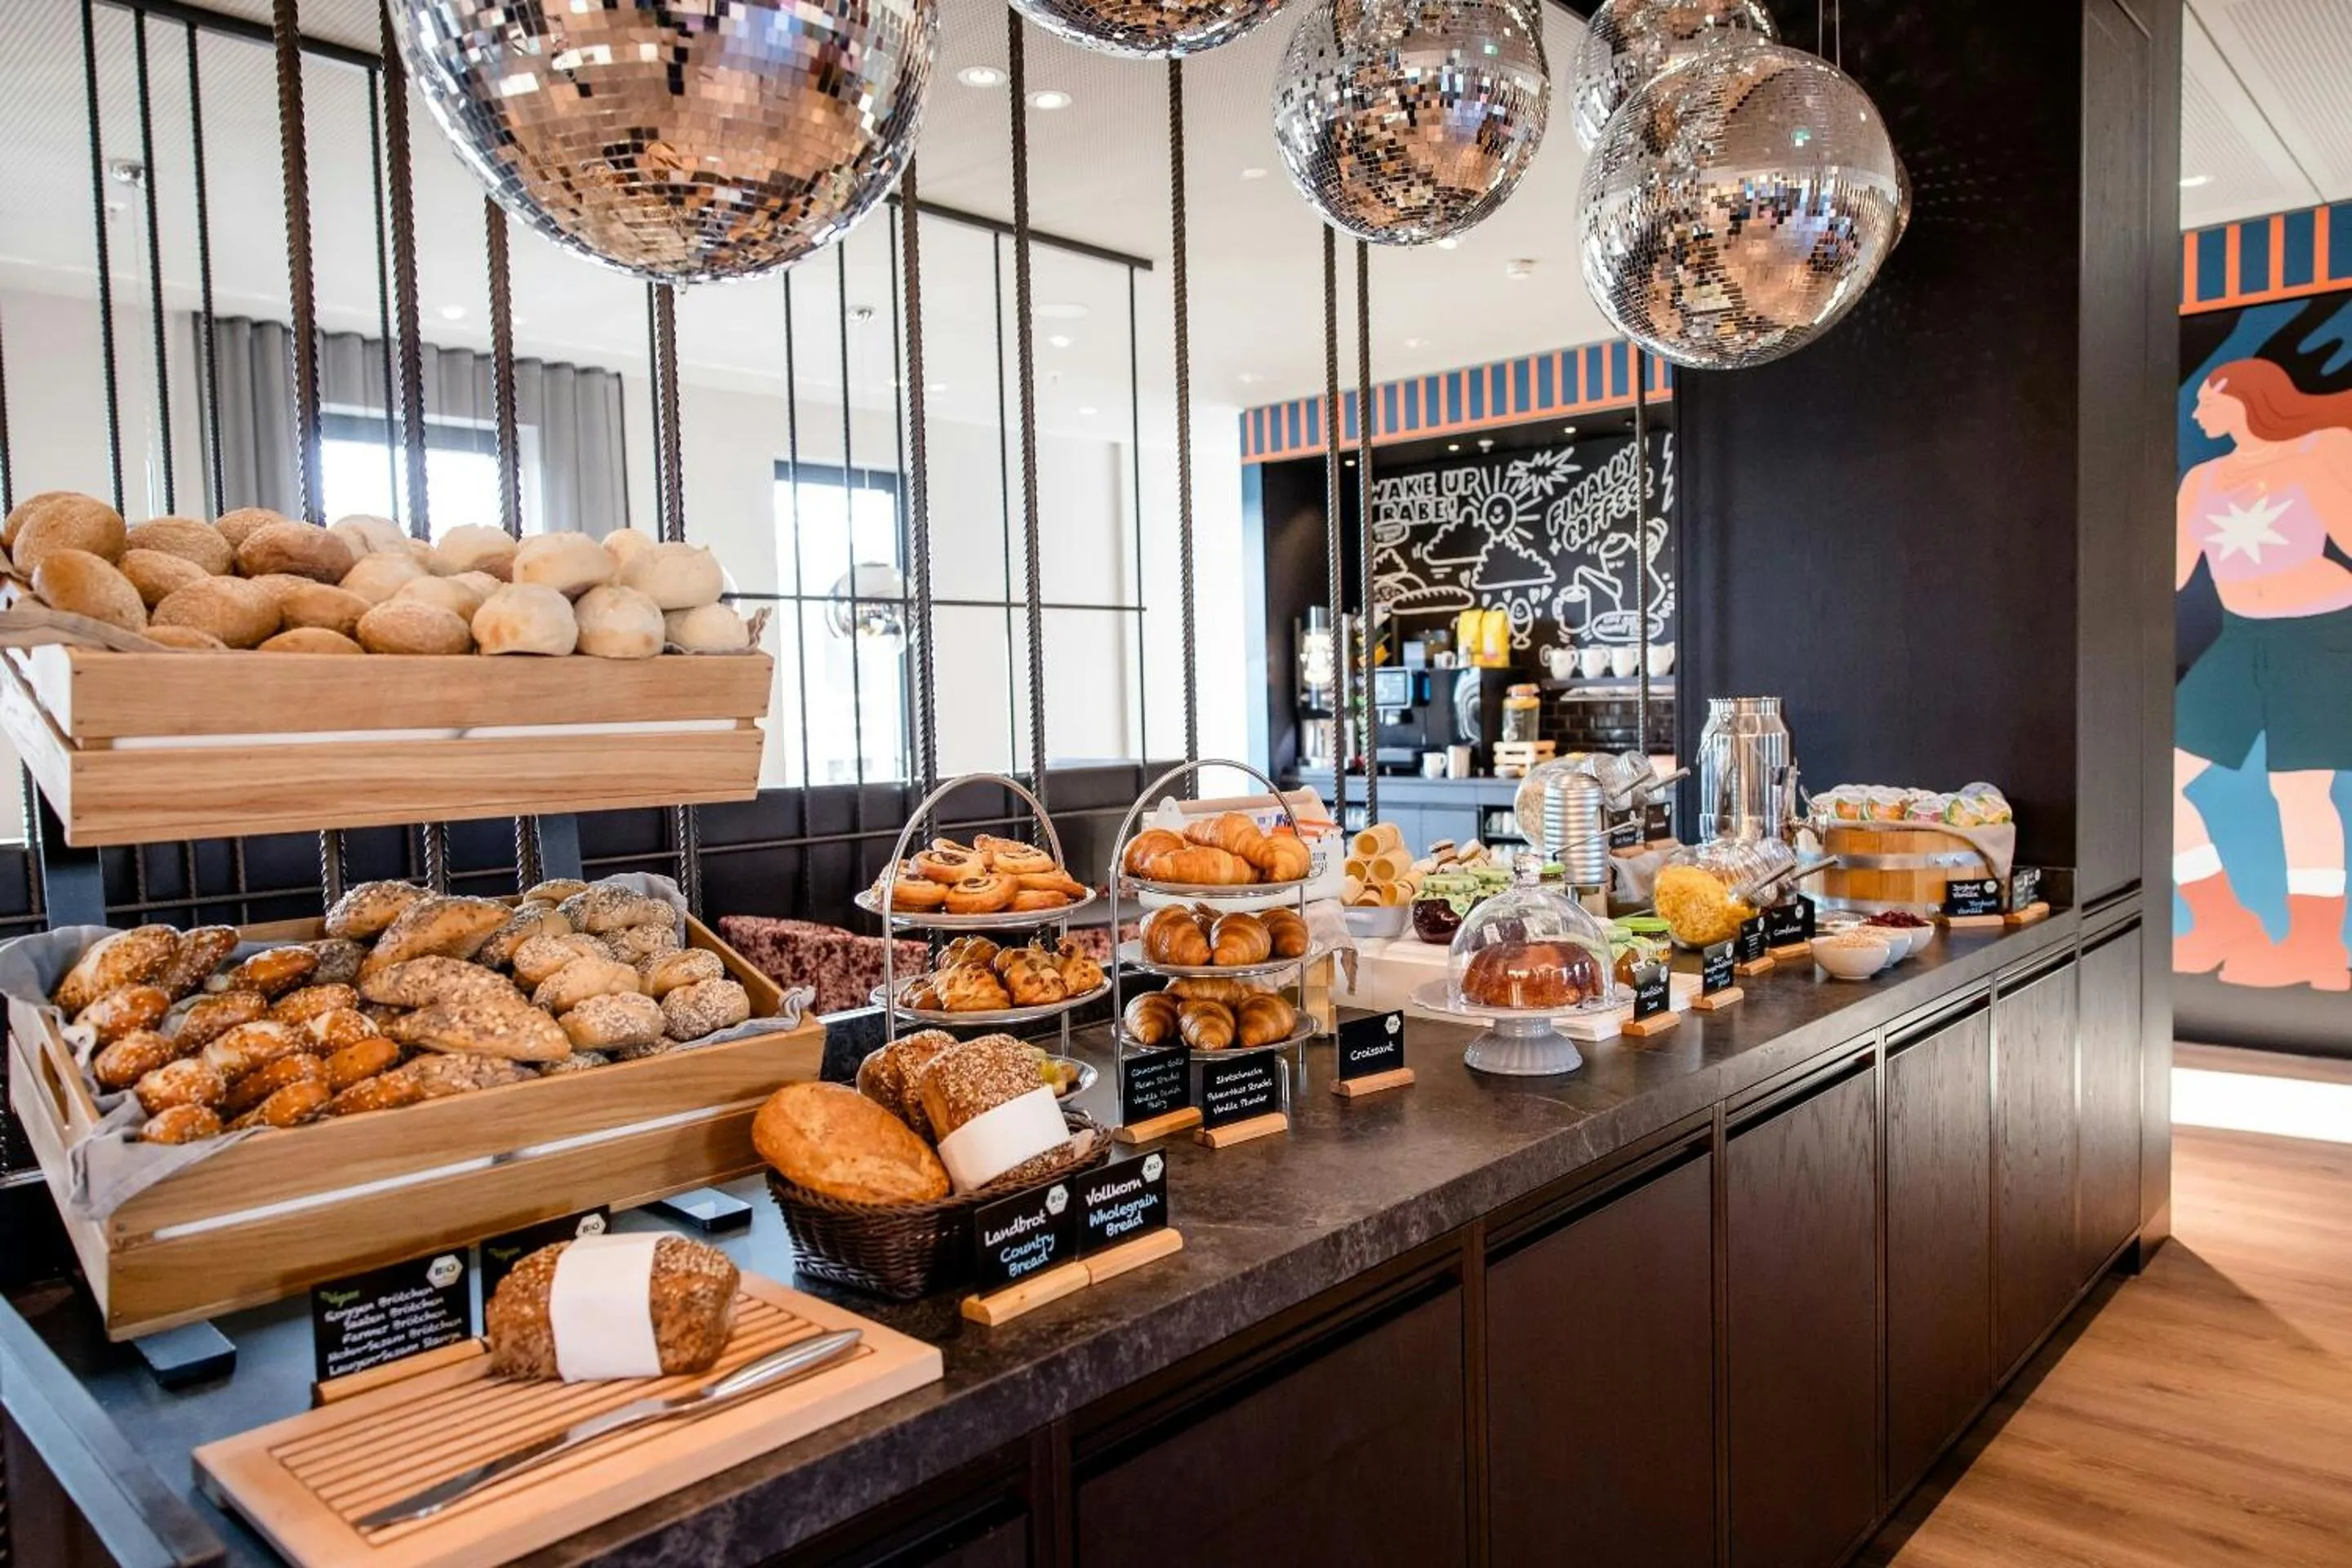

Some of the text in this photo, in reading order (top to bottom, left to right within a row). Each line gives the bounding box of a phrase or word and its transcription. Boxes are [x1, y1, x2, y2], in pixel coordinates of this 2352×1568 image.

[1441, 467, 1480, 496] UP
[1546, 436, 1648, 536] FINALLY
[1380, 497, 1458, 525] BABE!
[1350, 1040, 1395, 1061] Croissant
[1085, 1178, 1143, 1206] Vollkorn
[1089, 1192, 1158, 1227] Wholegrain
[984, 1209, 1047, 1247] Landbrot
[1106, 1214, 1143, 1237] Bread
[1000, 1233, 1055, 1263] Country
[1009, 1250, 1049, 1277] Bread
[377, 1287, 434, 1307] Brötchen
[389, 1296, 445, 1318] Brötchen
[392, 1309, 448, 1330] Brötchen
